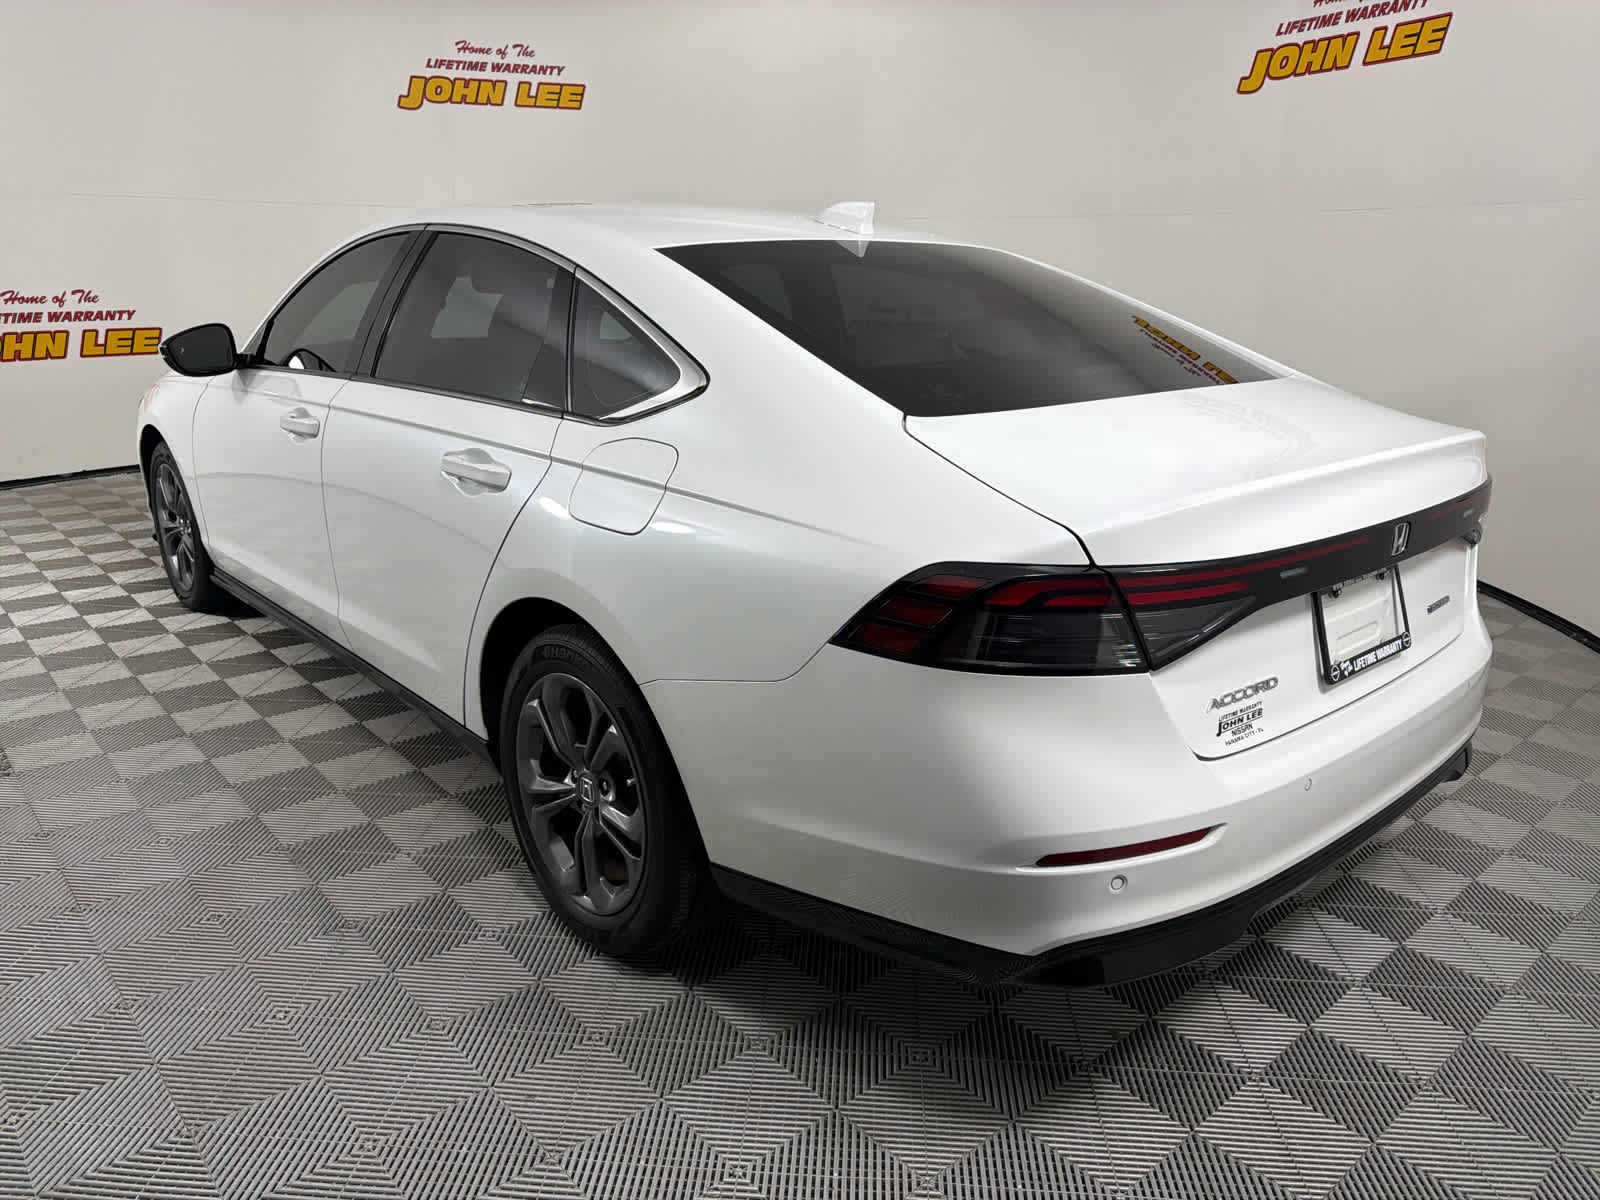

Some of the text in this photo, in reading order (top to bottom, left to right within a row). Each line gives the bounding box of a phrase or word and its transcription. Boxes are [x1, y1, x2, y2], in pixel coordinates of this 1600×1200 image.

[1276, 11, 1340, 36] LIFETIME
[455, 40, 536, 59] Home of The
[1237, 11, 1453, 95] JOHN LEE
[425, 58, 565, 76] LIFETIME WARRANTY
[397, 75, 586, 110] JOHN LEE
[0, 289, 100, 307] Home of The
[0, 310, 136, 324] TIME WARRANTY
[0, 327, 162, 362] HN LEE
[1354, 651, 1377, 671] LIFETIME
[1207, 677, 1278, 712] ACCORD
[1216, 708, 1263, 737] JOHN LEE
[1231, 724, 1253, 736] NISSAN
